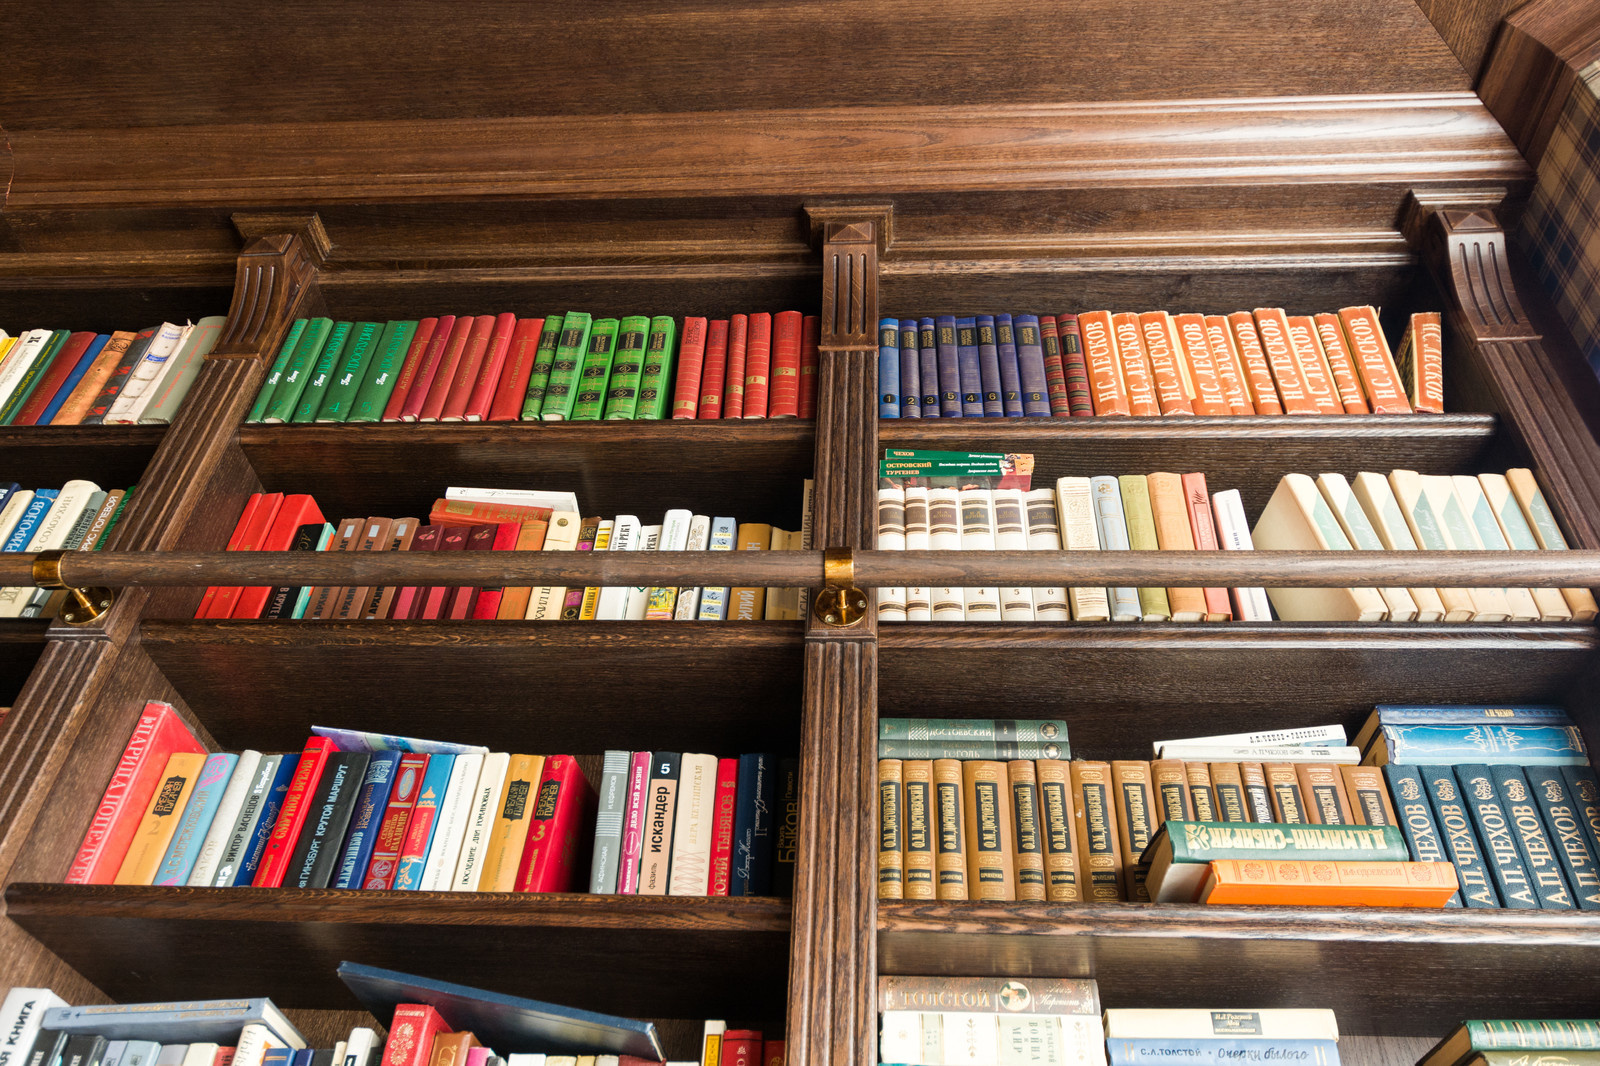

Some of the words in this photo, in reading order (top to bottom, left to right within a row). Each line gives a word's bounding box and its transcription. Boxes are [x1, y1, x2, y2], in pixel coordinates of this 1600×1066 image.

[317, 324, 349, 373] ПРОСКУРИН
[345, 324, 376, 373] ПРОСКУРИН
[379, 324, 408, 373] ПРОСКУРИН
[1086, 321, 1114, 376] ЛЕСКОВ
[1118, 323, 1146, 379] ЛЕСКОВ
[1144, 322, 1176, 377] ЛЕСКОВ
[1183, 323, 1216, 379] ЛЕСКОВ
[1237, 322, 1271, 380] ЛЕСКОВ
[1260, 319, 1296, 375] ЛЕСКОВ
[1290, 326, 1326, 382] ЛЕСКОВ
[1350, 317, 1388, 374] ЛЕСКОВ
[1424, 344, 1444, 402] ЛЕСКОВ
[299, 403, 312, 416] 3
[328, 401, 341, 413] 4
[360, 401, 373, 414] 5
[907, 397, 916, 406] 2
[926, 396, 935, 404] 3
[946, 392, 956, 400] 5
[967, 394, 975, 403] 4
[988, 392, 997, 400] 6
[1008, 392, 1016, 400] 7
[1032, 393, 1041, 401] 8
[92, 496, 119, 533] ПОЛЕВОЙ
[270, 593, 287, 615] КРУГЕ
[890, 588, 896, 596] 1
[914, 587, 921, 596] 2
[944, 587, 951, 596] 3
[978, 588, 985, 596] 4
[1013, 588, 1021, 596] 5
[1047, 588, 1055, 596] 6
[929, 727, 993, 737] ДОСТОЕВСКИЙ
[109, 724, 153, 791] ЦАРИЦА
[660, 763, 672, 776] 5
[944, 750, 980, 758] ГОГОЛЬ
[155, 781, 175, 813] ЕМЕЛЬЯН
[163, 782, 183, 812] ПУГАЧЕВ
[274, 794, 302, 839] СМУТНОЕ
[292, 760, 314, 792] ВРЕМЯ
[476, 787, 492, 827] РОМАНОВЫХ
[505, 783, 519, 816] ЕМЕЛЬЯН
[513, 784, 528, 816] ПУГАЧЕВ
[536, 785, 550, 817] ЕМЕЛЬЯН
[544, 785, 559, 817] ПУГАЧЕВ
[630, 810, 638, 829] ДЕЛО
[635, 766, 643, 790] ЖИЗНИ
[691, 765, 703, 821] КЕТЛИНСКАЯ
[147, 820, 162, 836] 2
[226, 834, 244, 863] ВИКТОР
[239, 795, 260, 832] ВАСНЕЦОВ
[300, 839, 321, 882] ГИНЗБУРГ
[315, 804, 335, 837] КРУТОЙ
[327, 764, 349, 803] МАРШРУТ
[361, 804, 376, 829] НОВИК
[390, 812, 408, 851] ВЛАДИМИР
[531, 824, 546, 842] 3
[689, 823, 698, 845] ВЕРА
[717, 795, 734, 852] ТЫНЯНОВ
[778, 802, 798, 863] БЫКОВ
[1404, 804, 1442, 862] ЧЕХОВ
[473, 829, 481, 844] ДНИ
[1441, 805, 1479, 867] ЧЕХОВ
[1478, 804, 1516, 865] ЧЕХОВ
[1513, 806, 1553, 868] ЧЕХОВ
[1551, 806, 1592, 868] ЧЕХОВ
[462, 846, 477, 885] ПОСЛЕДНИЕ
[714, 857, 729, 896] ЮРИЙ
[1461, 867, 1494, 906] А.П.
[1501, 866, 1535, 905] А.П.
[1536, 867, 1572, 907] А.П.
[903, 988, 991, 1008] ТОЛСТОЙ
[9, 1000, 36, 1046] КНИГА
[1013, 1027, 1023, 1054] МИР
[1029, 1021, 1042, 1061] ВОЙНА
[1140, 1048, 1202, 1057] С.Л.ТОЛСТОЙ
[1218, 1048, 1261, 1061] Очерки
[1264, 1047, 1309, 1060] былого
